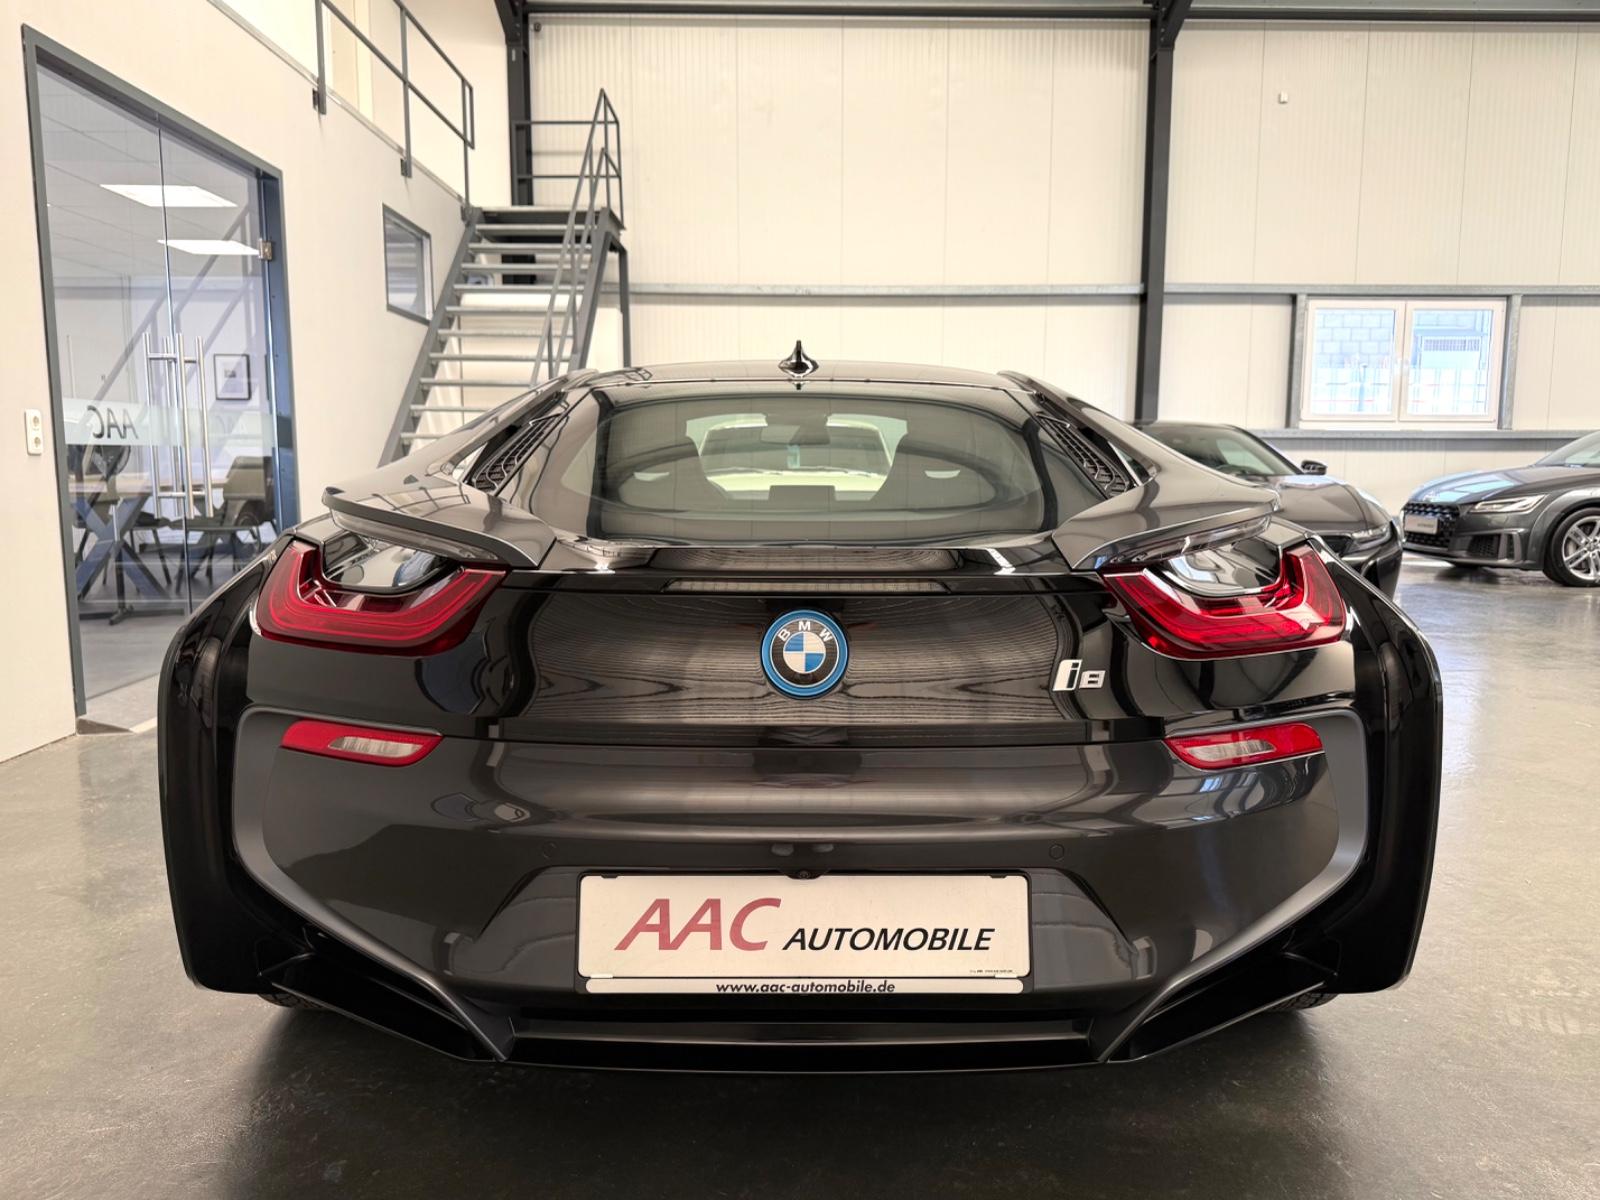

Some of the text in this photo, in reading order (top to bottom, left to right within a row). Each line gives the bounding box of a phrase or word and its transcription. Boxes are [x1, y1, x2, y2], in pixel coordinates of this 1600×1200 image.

[778, 620, 833, 642] BMW
[1052, 659, 1106, 691] i8
[614, 897, 996, 951] AAC AUTOMOBILE
[716, 980, 896, 993] www.aac-automobile.de
